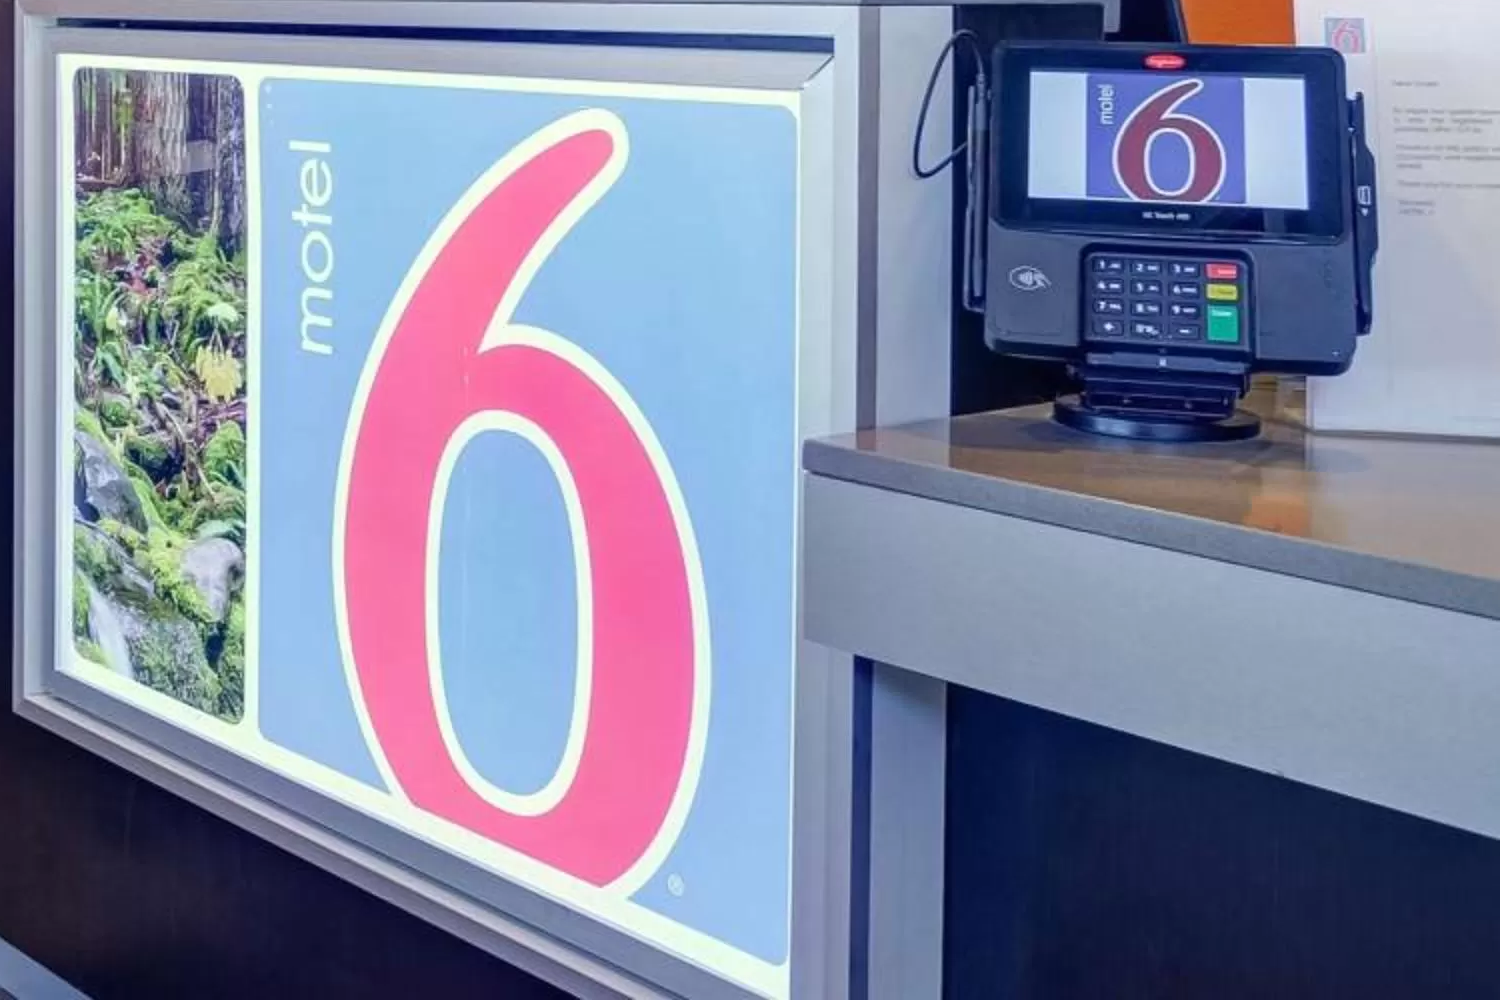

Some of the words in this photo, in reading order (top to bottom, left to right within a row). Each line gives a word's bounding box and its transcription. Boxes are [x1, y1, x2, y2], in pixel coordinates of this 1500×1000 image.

[1112, 78, 1226, 203] 6
[288, 140, 333, 355] motel
[332, 107, 711, 899] 6
